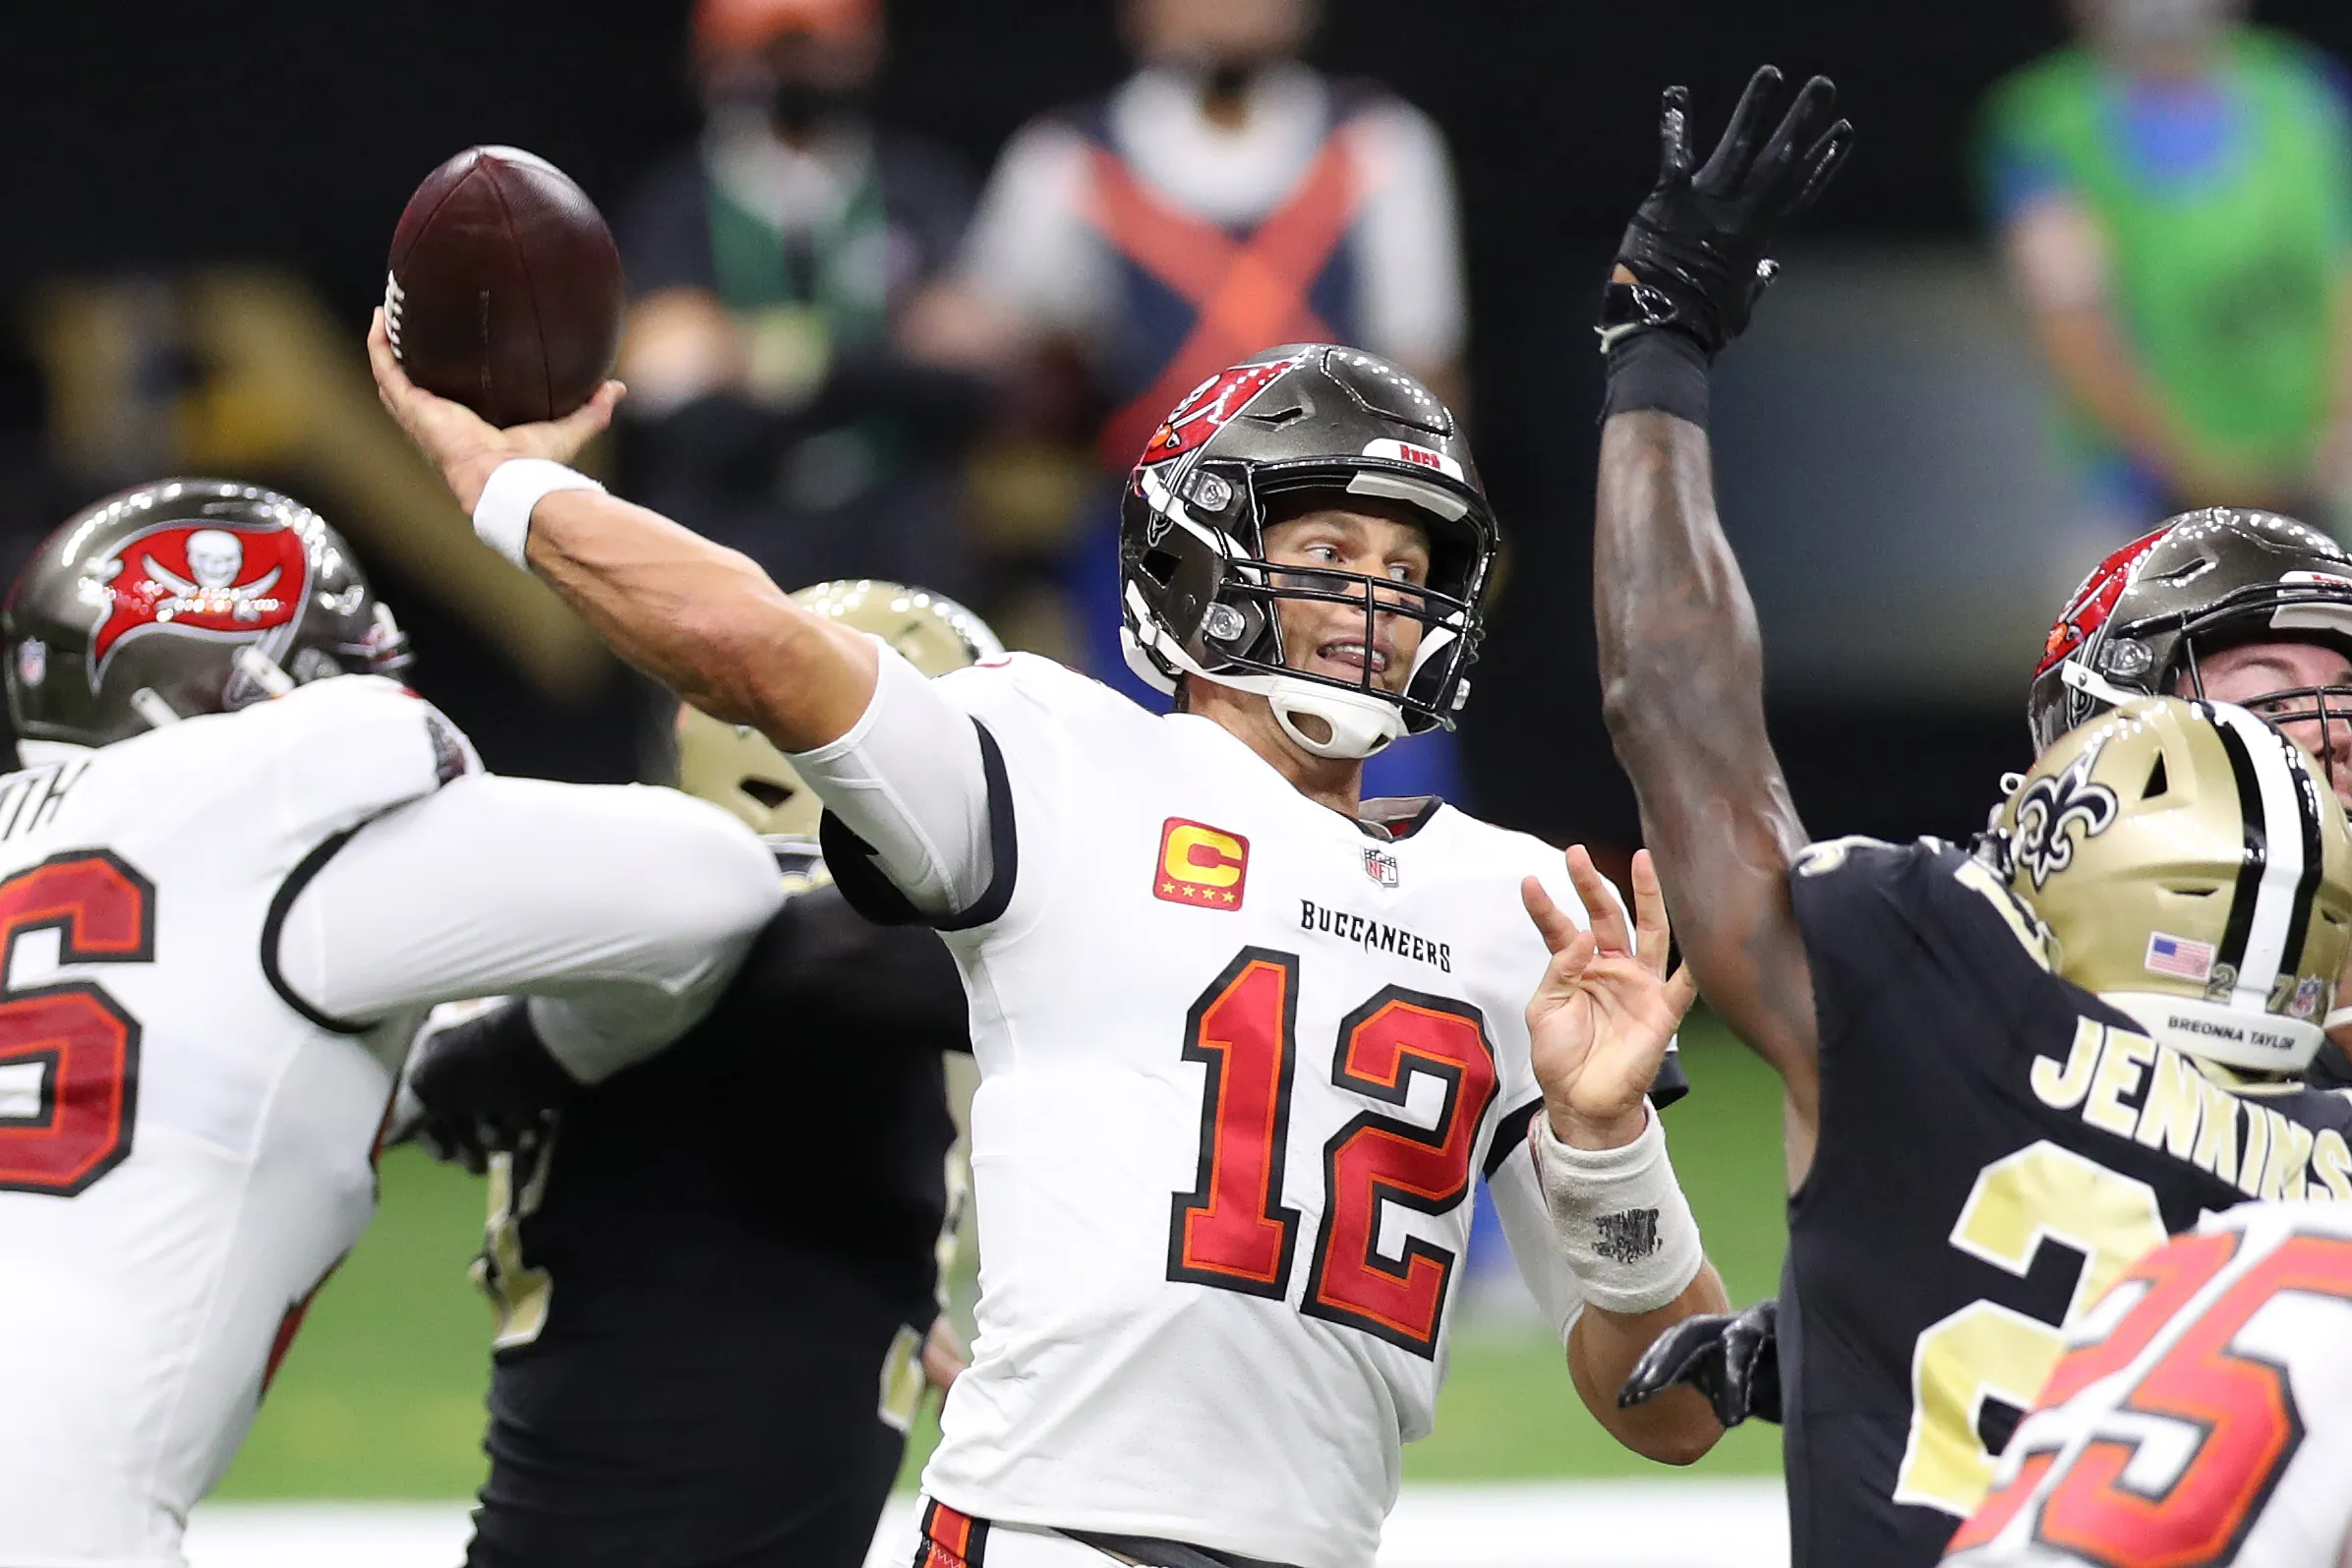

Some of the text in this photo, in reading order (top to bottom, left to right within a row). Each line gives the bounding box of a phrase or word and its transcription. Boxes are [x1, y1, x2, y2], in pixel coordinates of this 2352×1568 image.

[1164, 824, 1243, 888] C
[1300, 899, 1451, 973] BUCCANEERS
[2167, 1015, 2296, 1051] BREONNA TAYLOR
[2029, 1016, 2352, 1201] JENKINS
[1166, 945, 1500, 1363] 12
